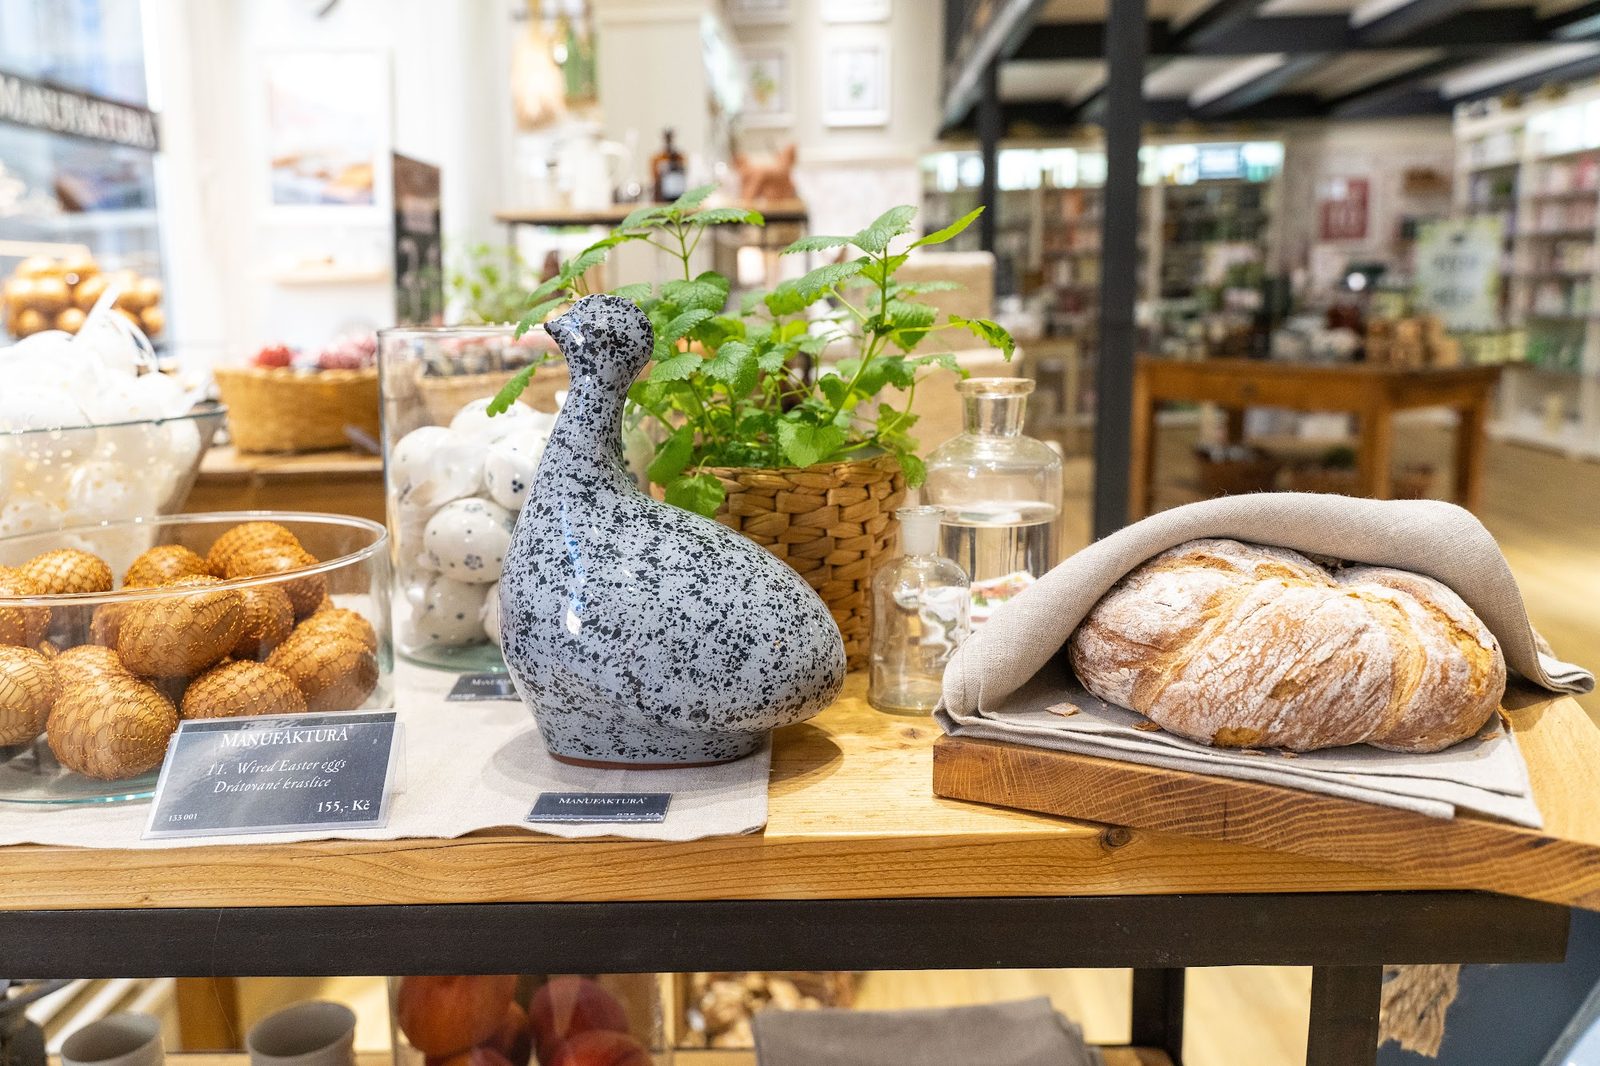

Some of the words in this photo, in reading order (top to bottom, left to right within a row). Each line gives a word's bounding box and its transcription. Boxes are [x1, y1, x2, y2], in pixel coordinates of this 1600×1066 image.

[220, 727, 349, 748] MANUFAKTURA
[237, 759, 279, 775] Wired
[278, 759, 321, 772] Easter
[321, 759, 347, 773] eggs
[213, 777, 284, 793] Drátované
[282, 775, 332, 789] kraslice
[316, 801, 349, 813] 155,-
[352, 799, 371, 811] Kč
[558, 796, 645, 804] MANUFAKTURA
